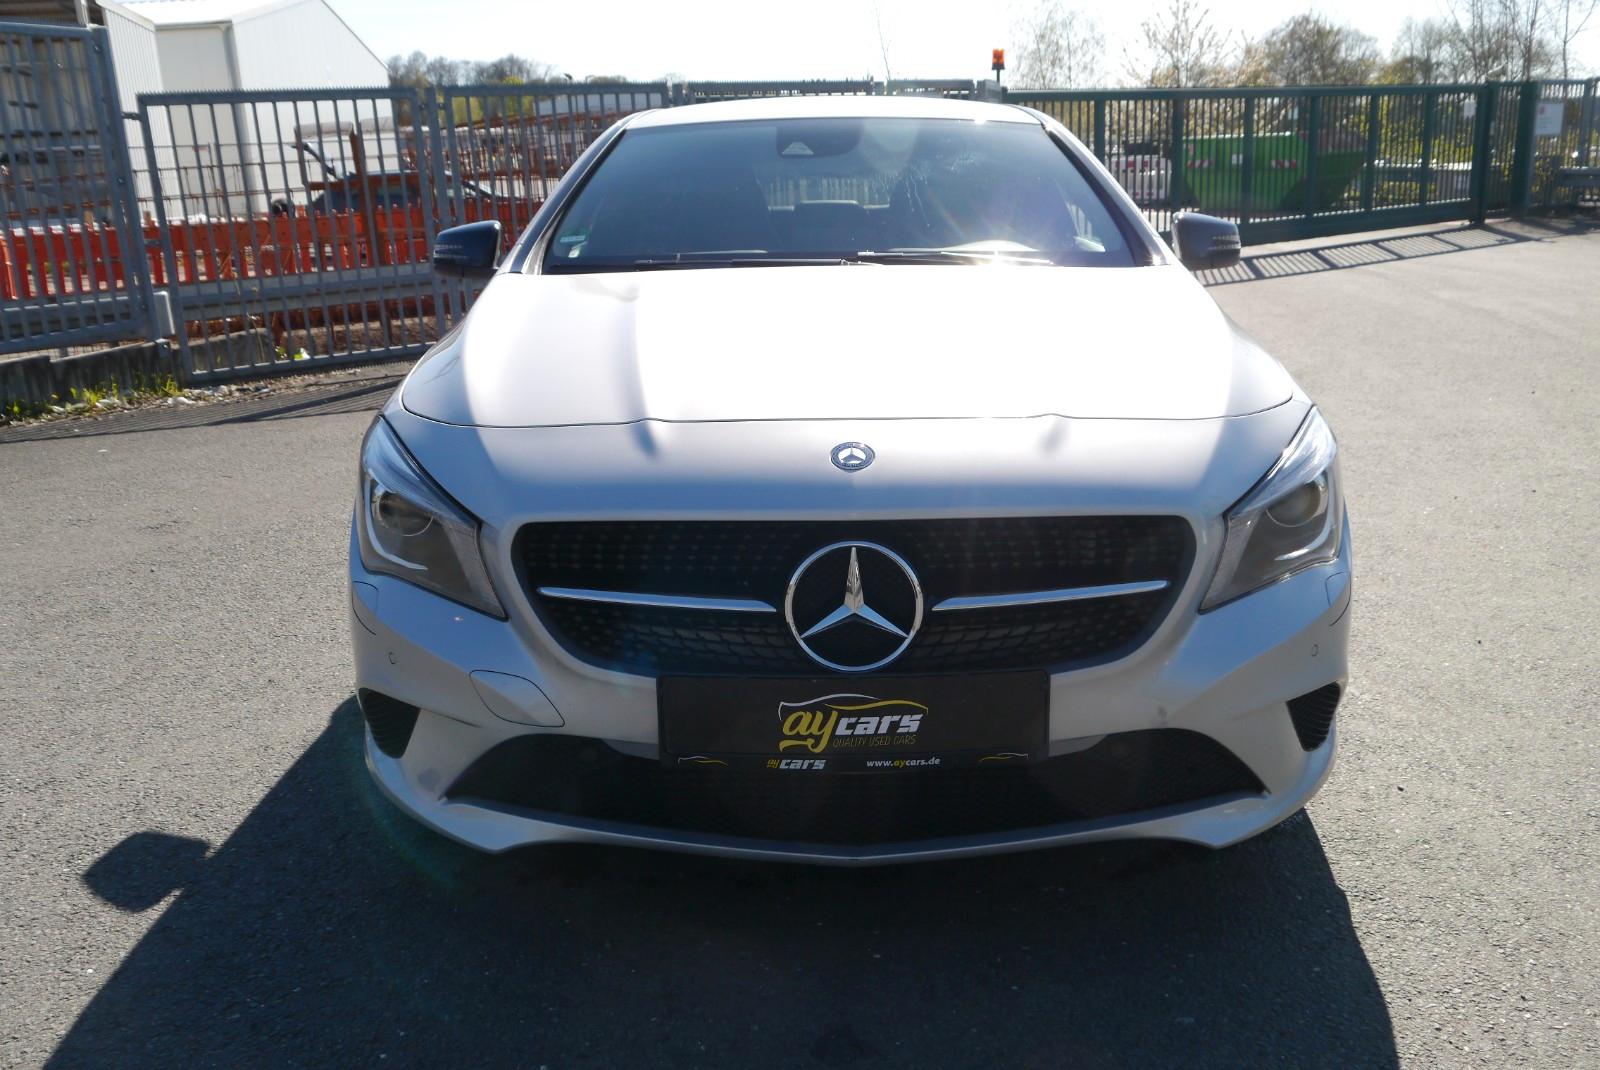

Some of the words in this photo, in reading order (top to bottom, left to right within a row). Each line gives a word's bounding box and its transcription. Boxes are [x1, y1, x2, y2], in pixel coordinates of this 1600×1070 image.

[832, 737, 868, 749] QUALITY
[869, 736, 890, 746] USED
[893, 735, 917, 745] CARS
[866, 757, 941, 768] www.aycars.de
